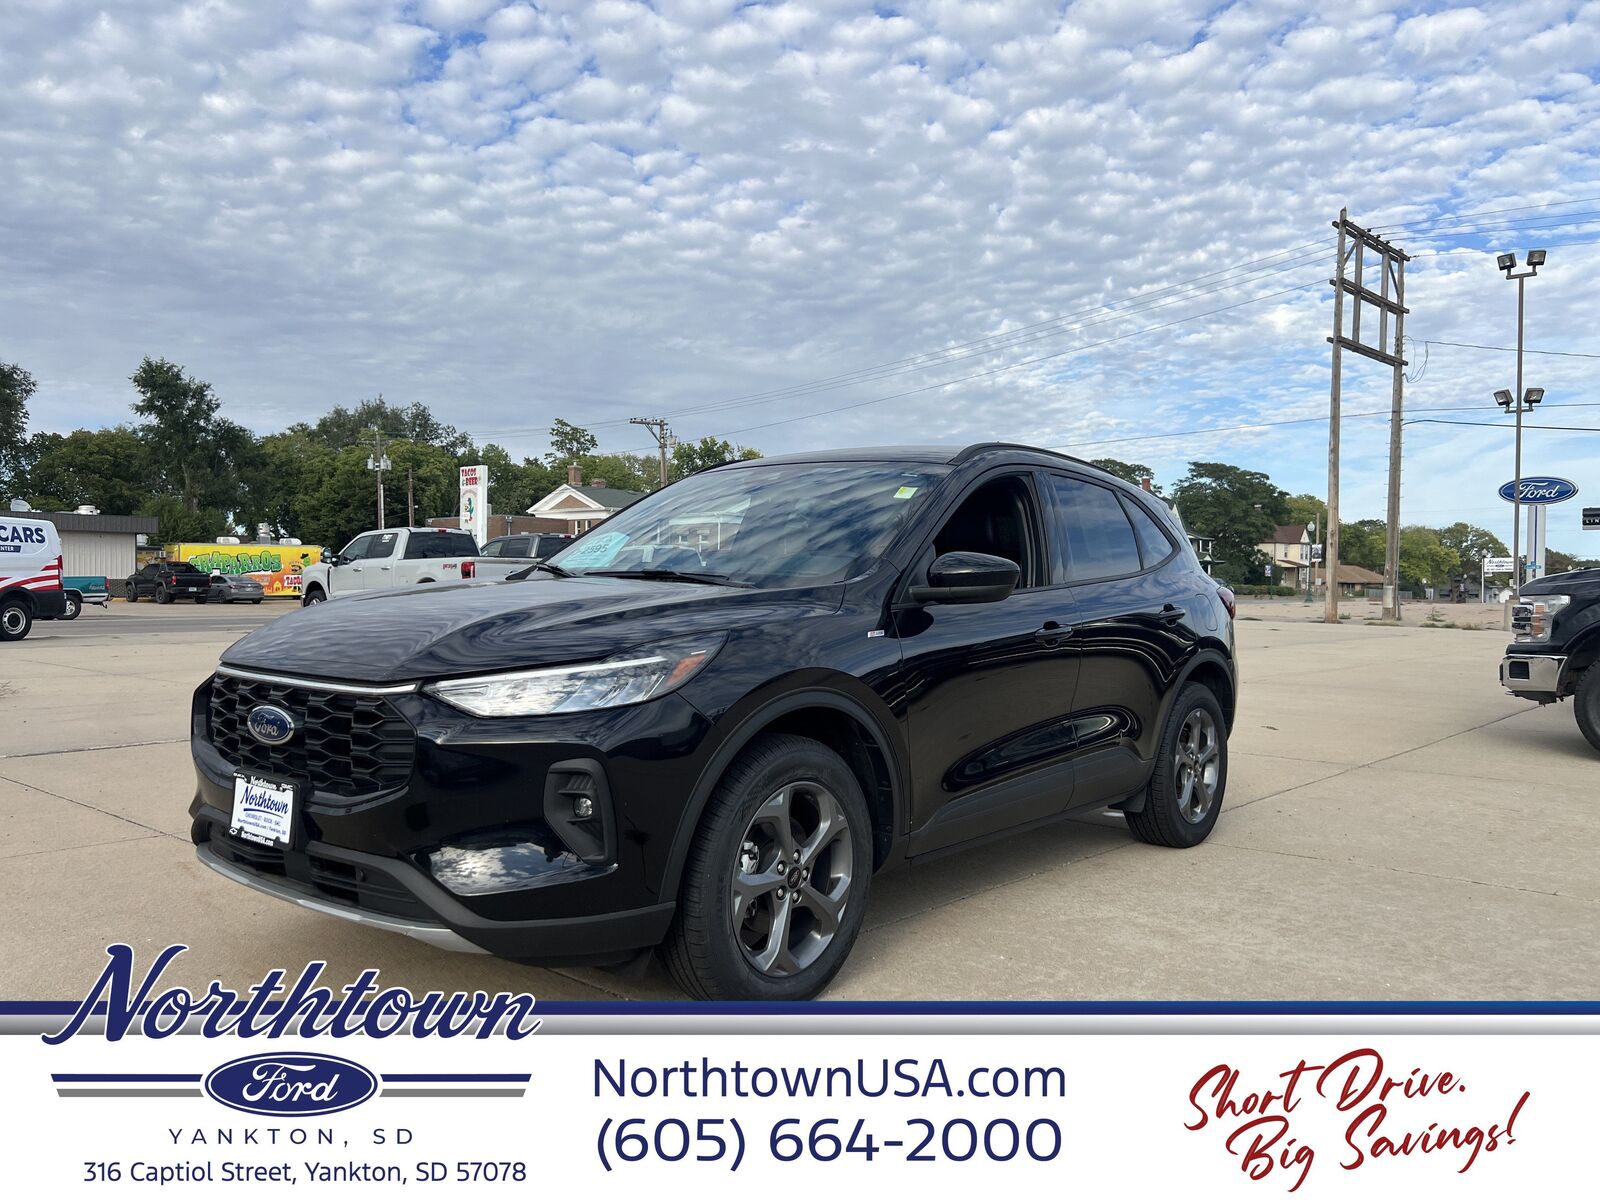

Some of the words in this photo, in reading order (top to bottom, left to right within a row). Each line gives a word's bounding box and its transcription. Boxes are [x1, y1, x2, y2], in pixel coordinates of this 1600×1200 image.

[1514, 482, 1559, 499] Ford
[0, 525, 45, 544] CARS
[254, 712, 280, 736] Ford
[240, 785, 289, 814] Northtown
